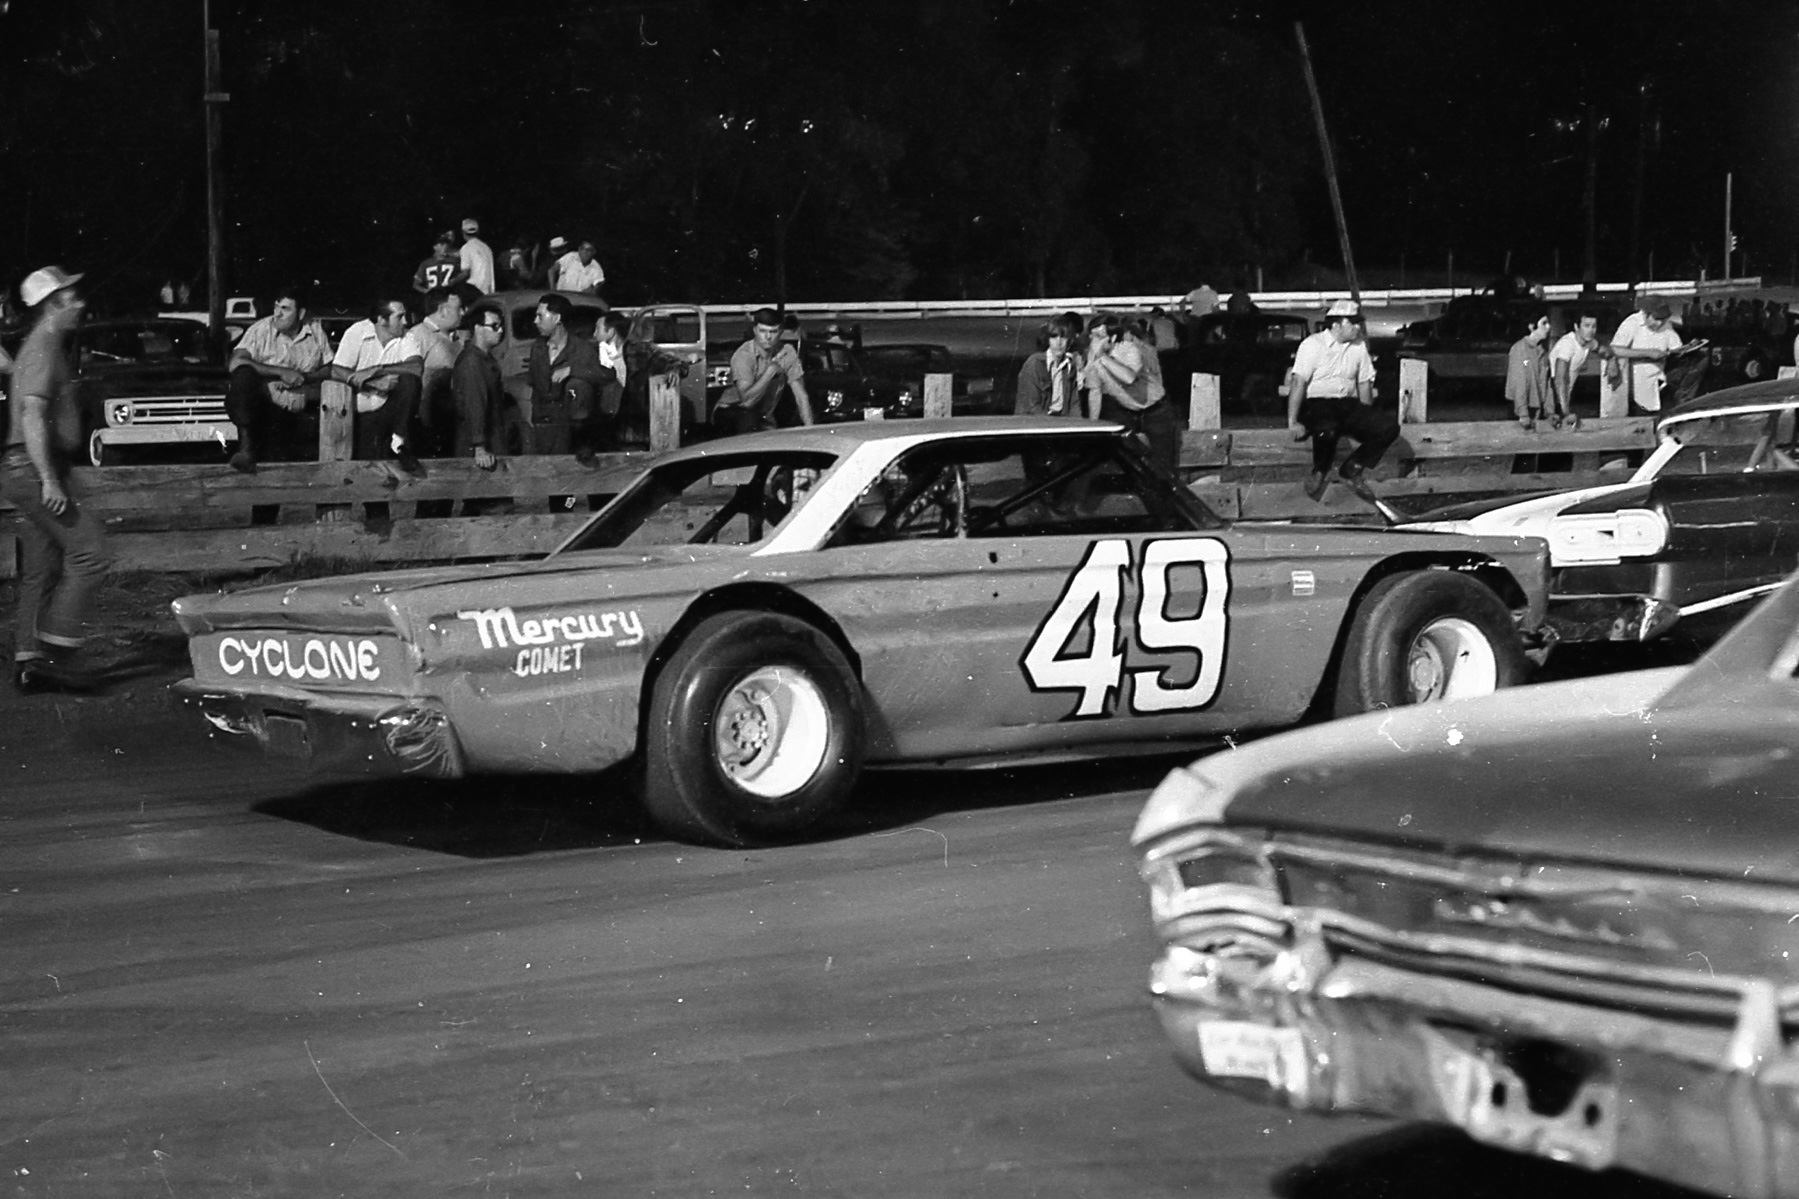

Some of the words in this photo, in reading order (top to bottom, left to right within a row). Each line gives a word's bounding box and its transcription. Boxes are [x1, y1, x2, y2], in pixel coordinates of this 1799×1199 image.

[424, 263, 454, 289] 57
[457, 605, 644, 650] Mercury
[1021, 537, 1229, 716] 49
[218, 637, 382, 681] CYCLONE
[514, 641, 585, 677] COMET
